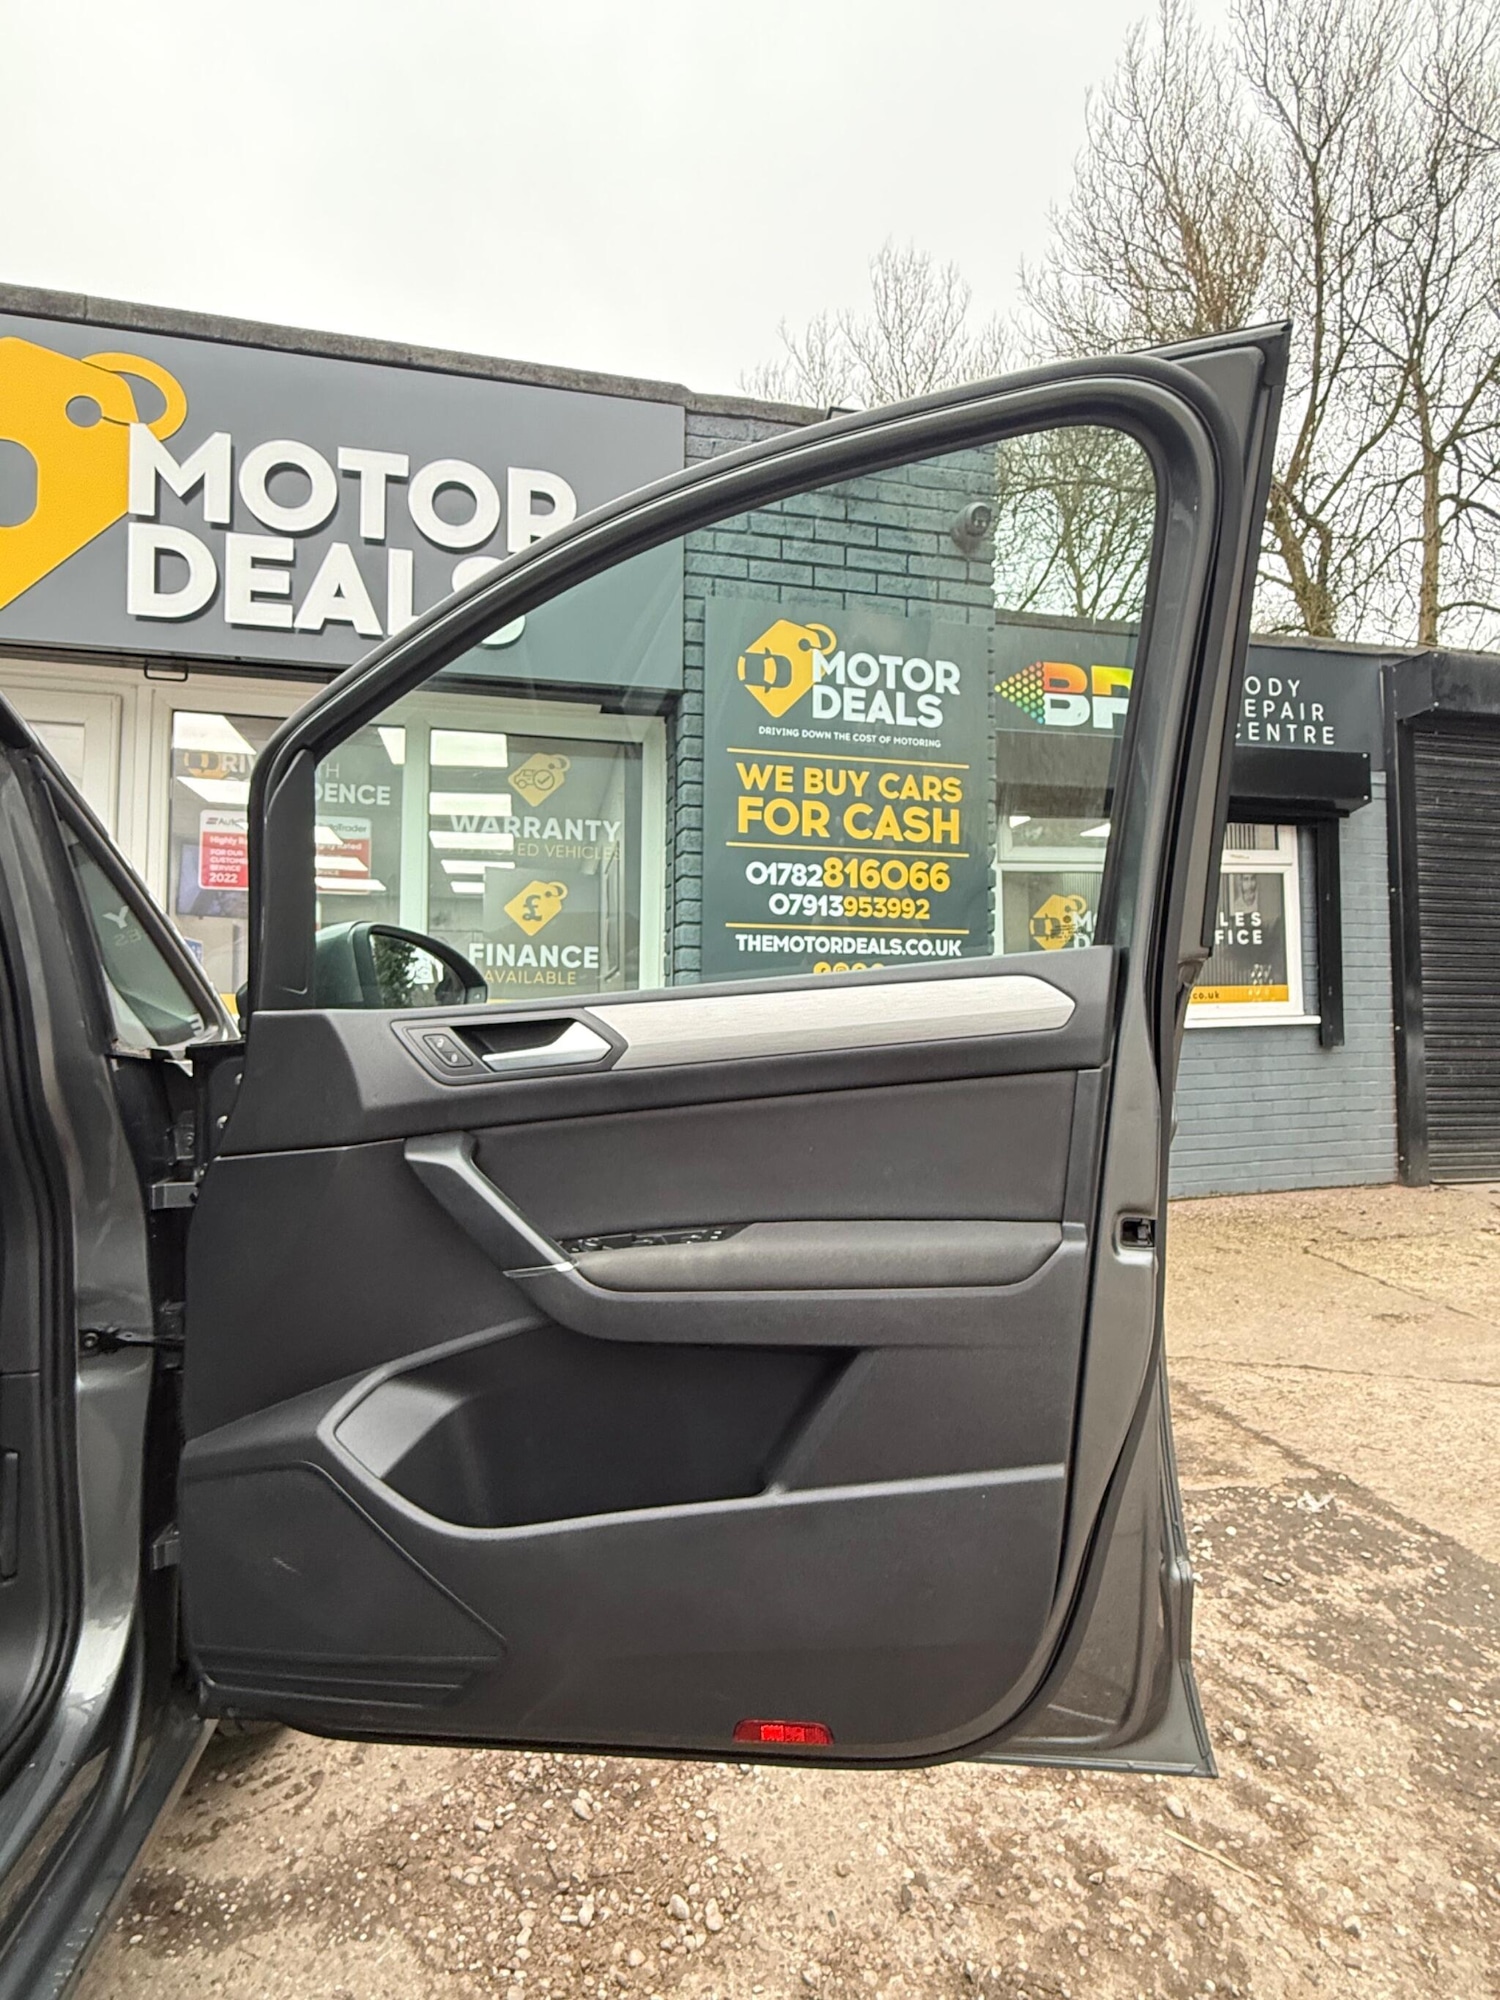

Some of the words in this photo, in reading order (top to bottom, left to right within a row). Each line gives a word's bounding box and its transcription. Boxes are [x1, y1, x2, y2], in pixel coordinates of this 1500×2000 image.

[129, 422, 577, 552] MOTOR
[812, 649, 960, 695] MOTOR
[1245, 676, 1300, 698] ODY
[812, 685, 943, 728] DEALS
[1244, 699, 1325, 722] EPAIR
[758, 725, 799, 738] DRIVING
[801, 729, 832, 740] DOWN
[833, 731, 851, 741] THE
[852, 733, 877, 743] COST
[878, 735, 892, 744] OF
[893, 737, 941, 748] MOTORING
[1236, 722, 1335, 745] ENTRE
[316, 782, 391, 806] ENCE
[736, 763, 794, 793] WE
[804, 767, 870, 797] BUY
[879, 773, 963, 803] CARS
[451, 814, 621, 843] WARRANTY
[737, 796, 830, 838] FOR
[843, 804, 960, 844] CASH
[209, 848, 226, 856] FOR
[227, 849, 244, 857] OUR
[209, 864, 241, 872] SERVICE
[209, 872, 238, 883] 2022
[745, 857, 950, 892] 01782816066
[769, 893, 930, 920] 07913953992
[1219, 911, 1262, 927] LES
[735, 934, 962, 957] THEMOTORDEALS.CO.UK
[1215, 929, 1263, 945] FICE
[468, 943, 599, 969] FINANCE
[484, 969, 576, 985] AVAILABLE
